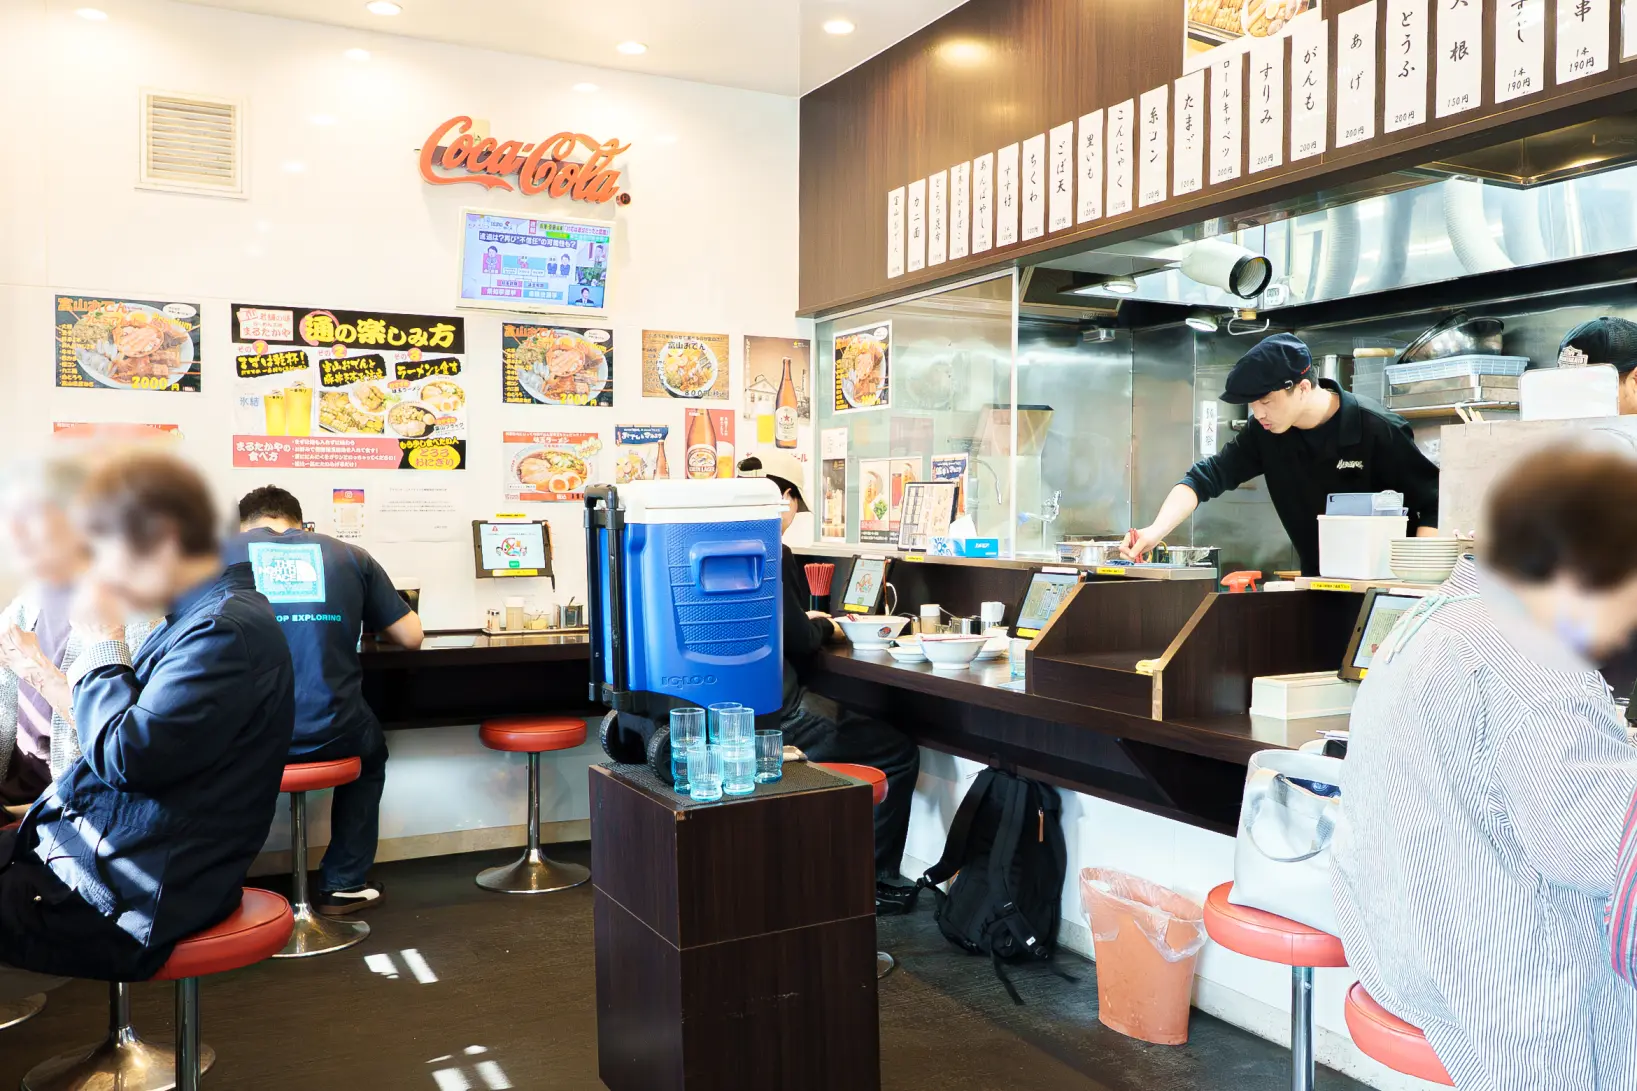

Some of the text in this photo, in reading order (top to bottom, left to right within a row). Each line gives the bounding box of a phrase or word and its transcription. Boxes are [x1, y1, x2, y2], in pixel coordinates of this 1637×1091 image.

[1397, 11, 1416, 78] とうふ
[1350, 33, 1364, 90] あげ
[1569, 56, 1595, 72] 190円
[1302, 45, 1318, 111] がんも
[1507, 77, 1531, 92] 190円
[1259, 62, 1273, 124] すりみ
[1447, 94, 1469, 108] 150円
[1222, 60, 1231, 158] ロールキャベツ
[1395, 110, 1415, 123] 200円
[1183, 94, 1195, 150] たまご
[1148, 106, 1159, 164] 糸コン
[1345, 126, 1365, 138] 200円
[1115, 109, 1125, 188] こんにゃく
[1299, 140, 1317, 153] 200円
[419, 115, 631, 204] Coca-Cola
[1056, 140, 1067, 194] ごぼ天
[1256, 154, 1274, 165] 200円
[1029, 153, 1038, 203] ちくわ
[1217, 166, 1233, 177] 200円
[57, 297, 127, 314] 富山おでん
[243, 327, 291, 337] まるたかや
[304, 314, 456, 348] 通の楽しみ方
[667, 341, 706, 351] 富山おでん
[239, 396, 260, 407] 氷結
[236, 441, 291, 452] まるたかやの
[248, 451, 279, 462] 食べ方
[416, 458, 454, 467] おにぎり
[292, 613, 341, 622] EXPLORING
